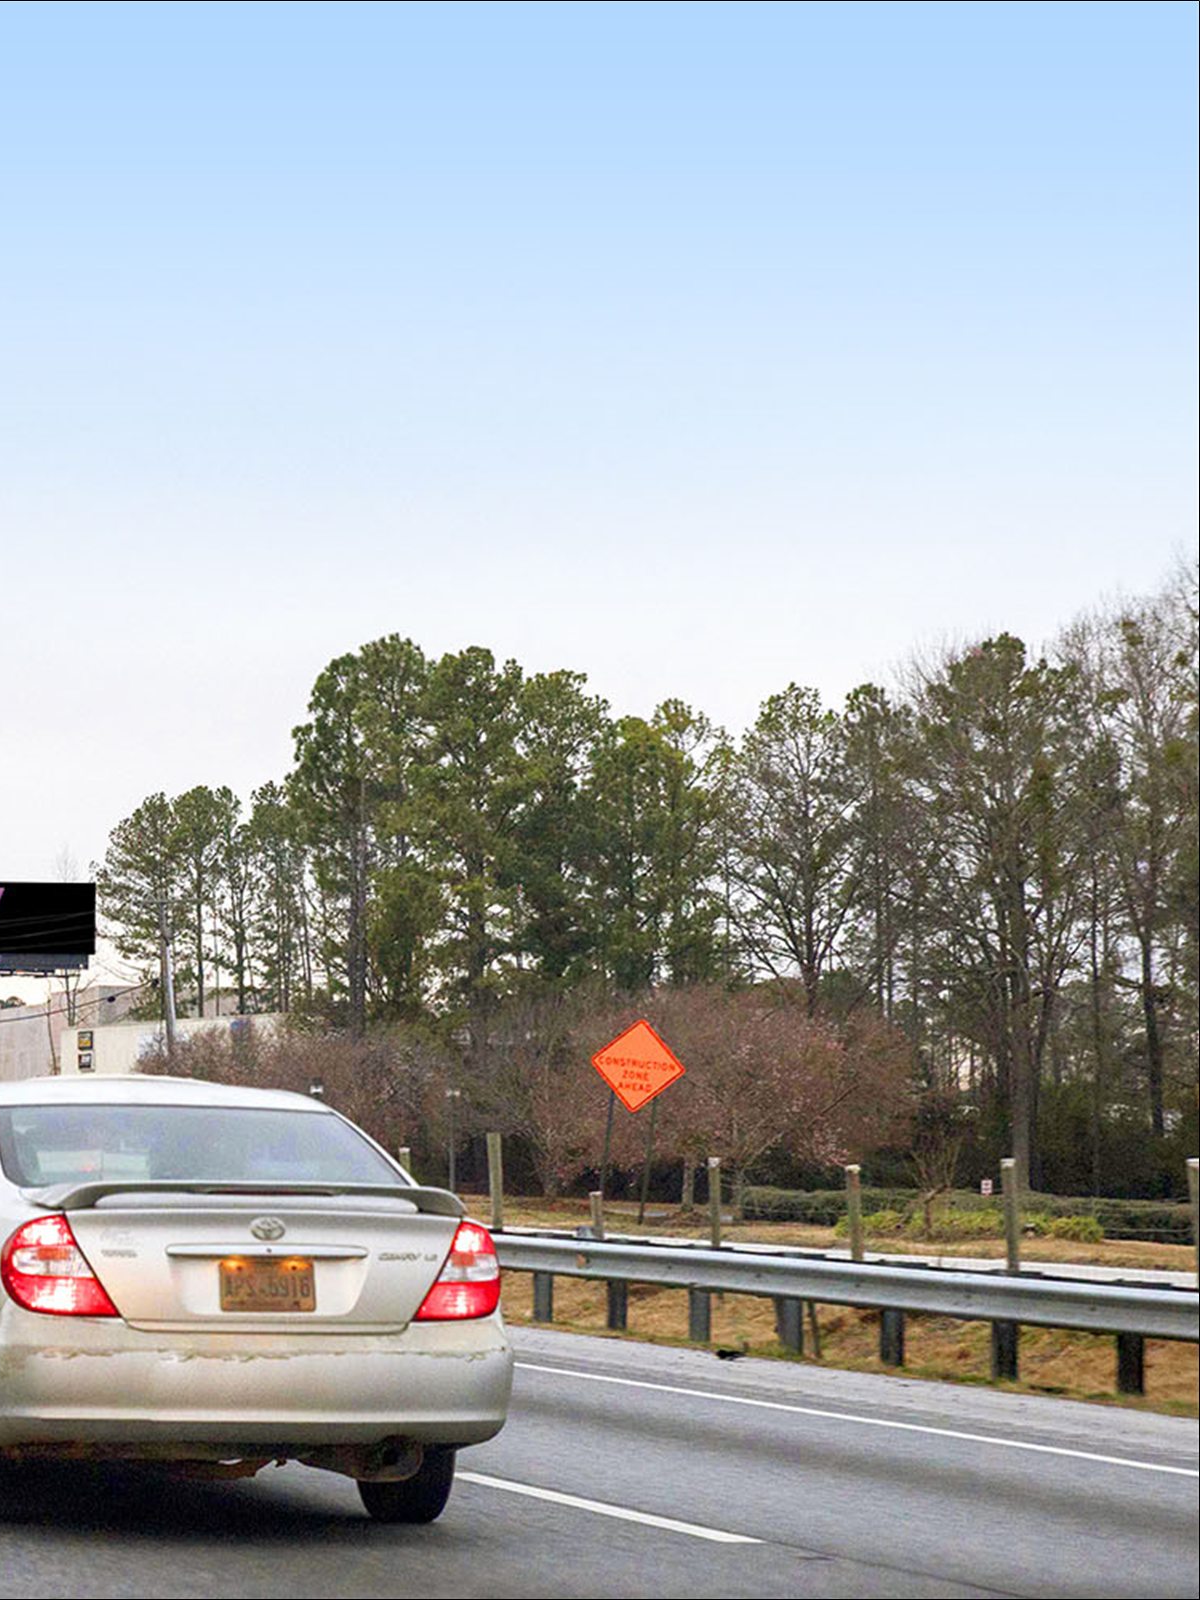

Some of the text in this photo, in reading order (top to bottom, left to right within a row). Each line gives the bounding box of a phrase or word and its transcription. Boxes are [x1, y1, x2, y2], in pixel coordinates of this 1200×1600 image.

[598, 1056, 676, 1072] CONSTRUCTION
[622, 1069, 649, 1081] ZONE
[619, 1082, 652, 1094] AHEAD
